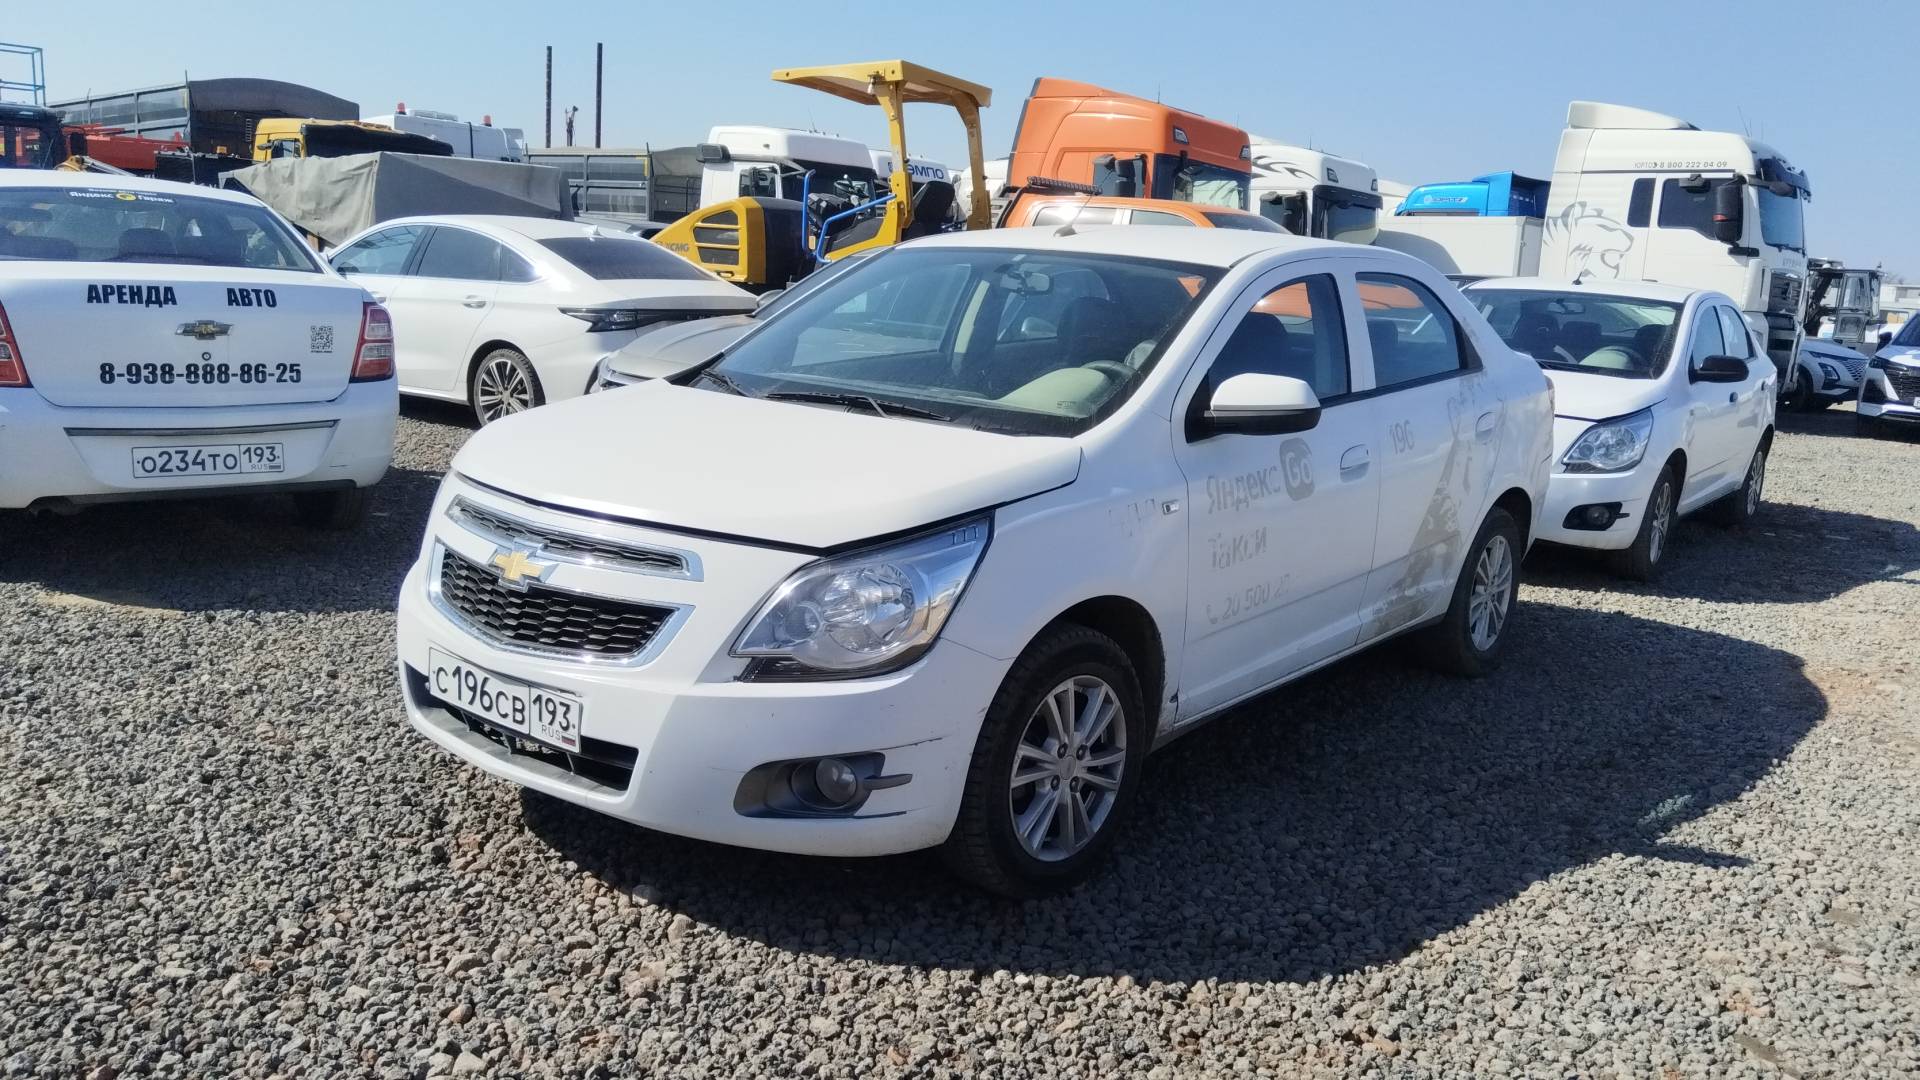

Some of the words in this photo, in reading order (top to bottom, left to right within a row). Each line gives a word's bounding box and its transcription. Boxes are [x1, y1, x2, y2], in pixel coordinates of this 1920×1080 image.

[87, 284, 178, 308] АРЕНДА
[227, 287, 277, 308] АВТО
[99, 362, 302, 385] 8-938-888-86-25
[243, 446, 276, 463] 193
[251, 463, 268, 471] RUS
[1206, 466, 1281, 514] Яндекс
[532, 693, 571, 732] 193
[541, 723, 561, 741] RUS
